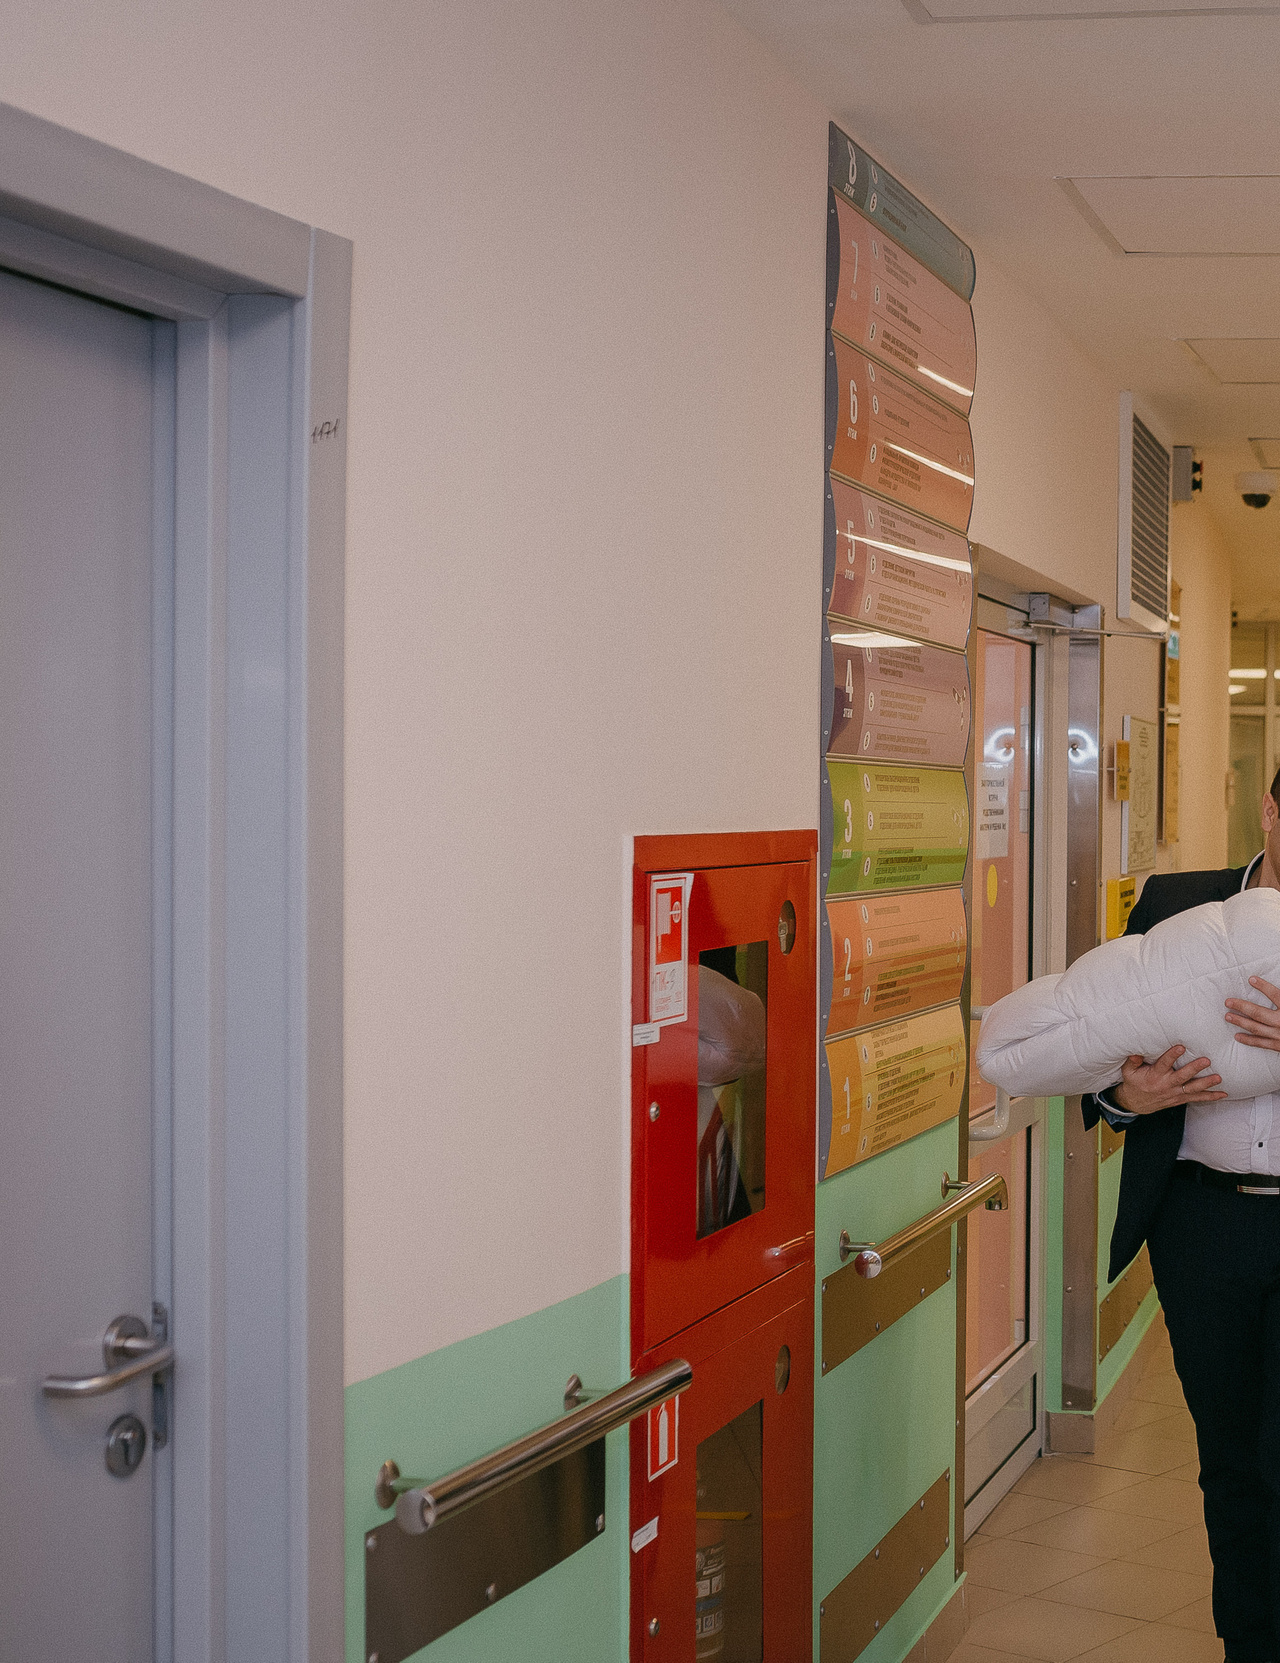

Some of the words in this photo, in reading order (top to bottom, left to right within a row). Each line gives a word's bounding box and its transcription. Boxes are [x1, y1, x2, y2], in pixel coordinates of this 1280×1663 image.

[848, 140, 857, 185] 8
[851, 240, 859, 284] 7
[850, 380, 858, 424] 6
[847, 520, 855, 565] 5
[845, 659, 854, 703] 4
[844, 799, 852, 843] 3
[844, 937, 852, 982] 2
[843, 1077, 850, 1119] 1
